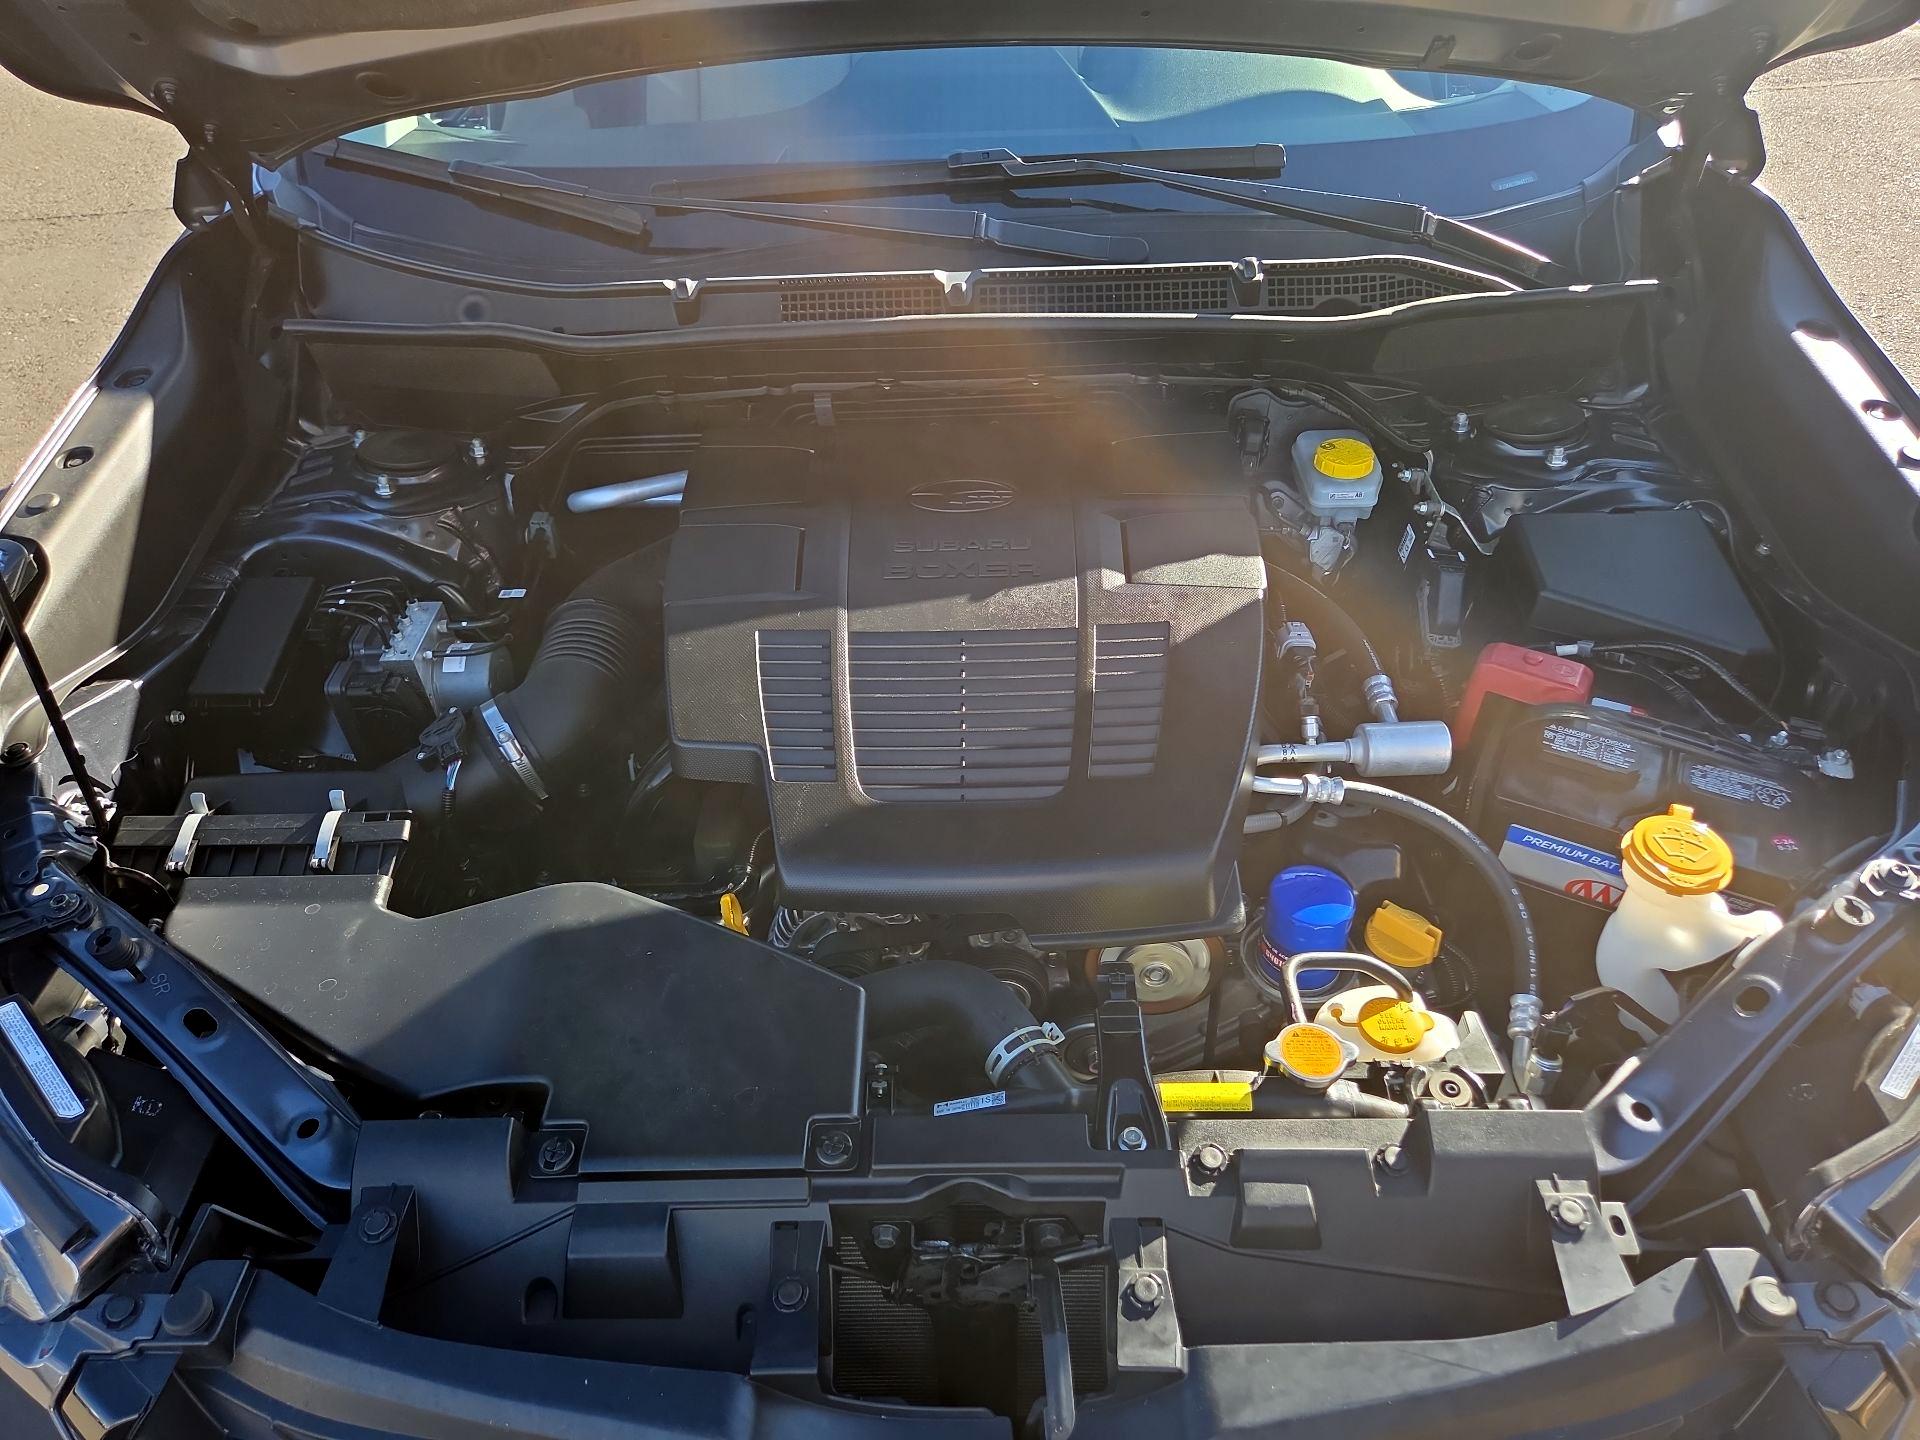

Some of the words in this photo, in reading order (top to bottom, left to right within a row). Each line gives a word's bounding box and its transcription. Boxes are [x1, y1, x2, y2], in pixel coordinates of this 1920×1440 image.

[892, 535, 1032, 553] SUBARU
[882, 560, 1041, 580] BOXER
[1522, 834, 1589, 860] PREMIUM
[1588, 856, 1623, 872] BAT
[1528, 949, 1537, 964] HP
[150, 973, 171, 997] SR
